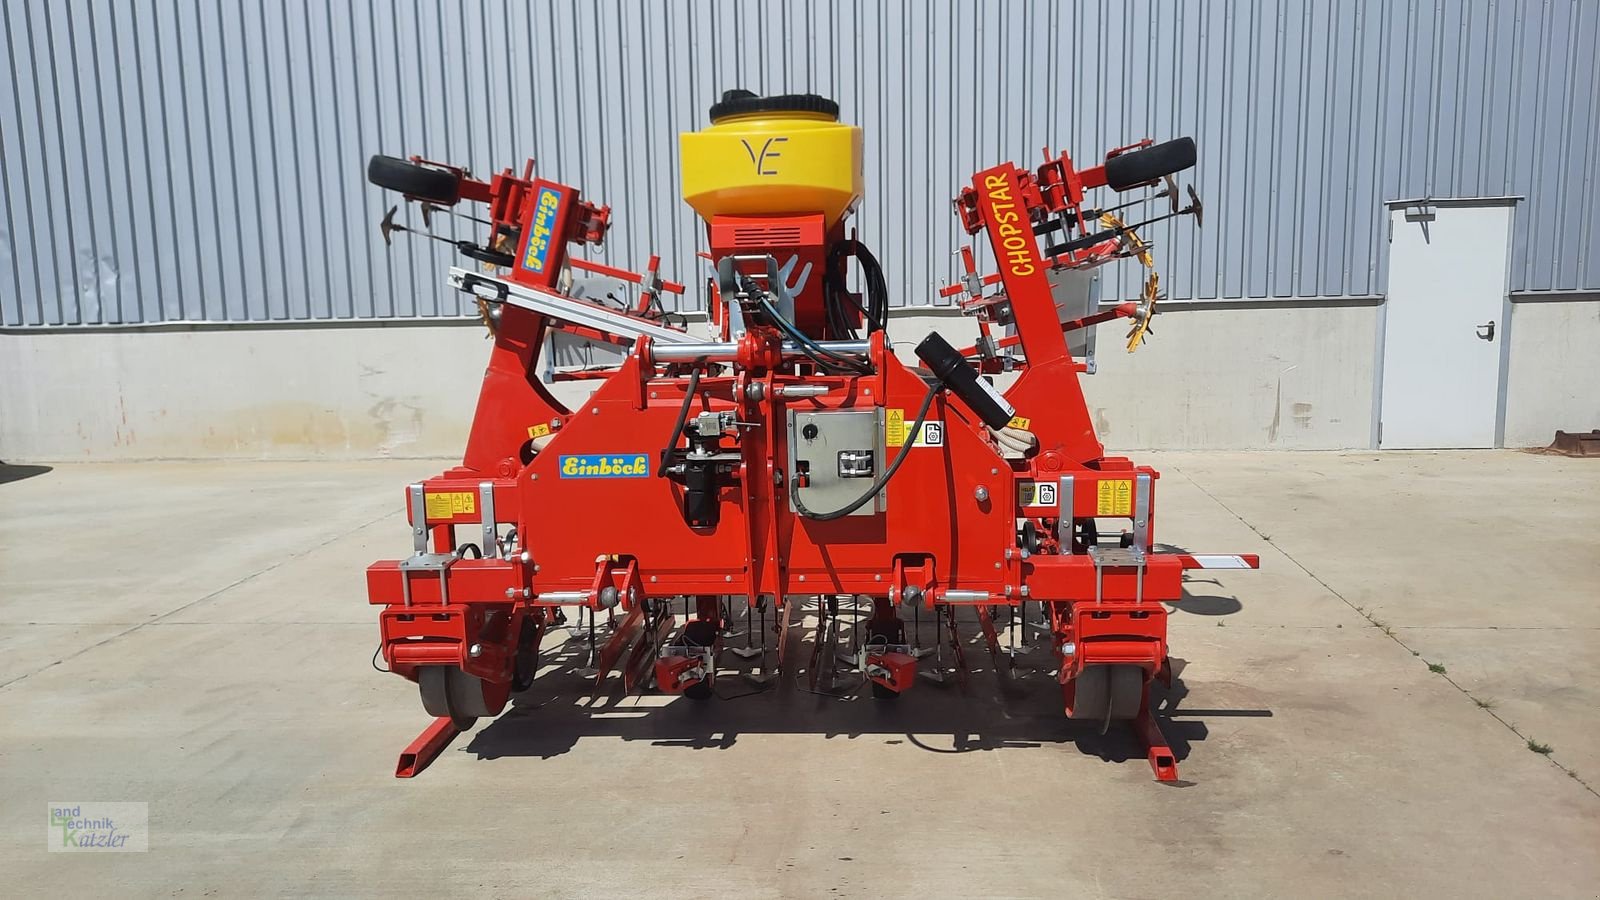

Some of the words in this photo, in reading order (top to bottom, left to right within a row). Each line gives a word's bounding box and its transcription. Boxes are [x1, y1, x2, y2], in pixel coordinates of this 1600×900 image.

[526, 191, 558, 270] Einböck
[985, 172, 1035, 276] CHOPSTAR
[562, 457, 646, 475] Einböck
